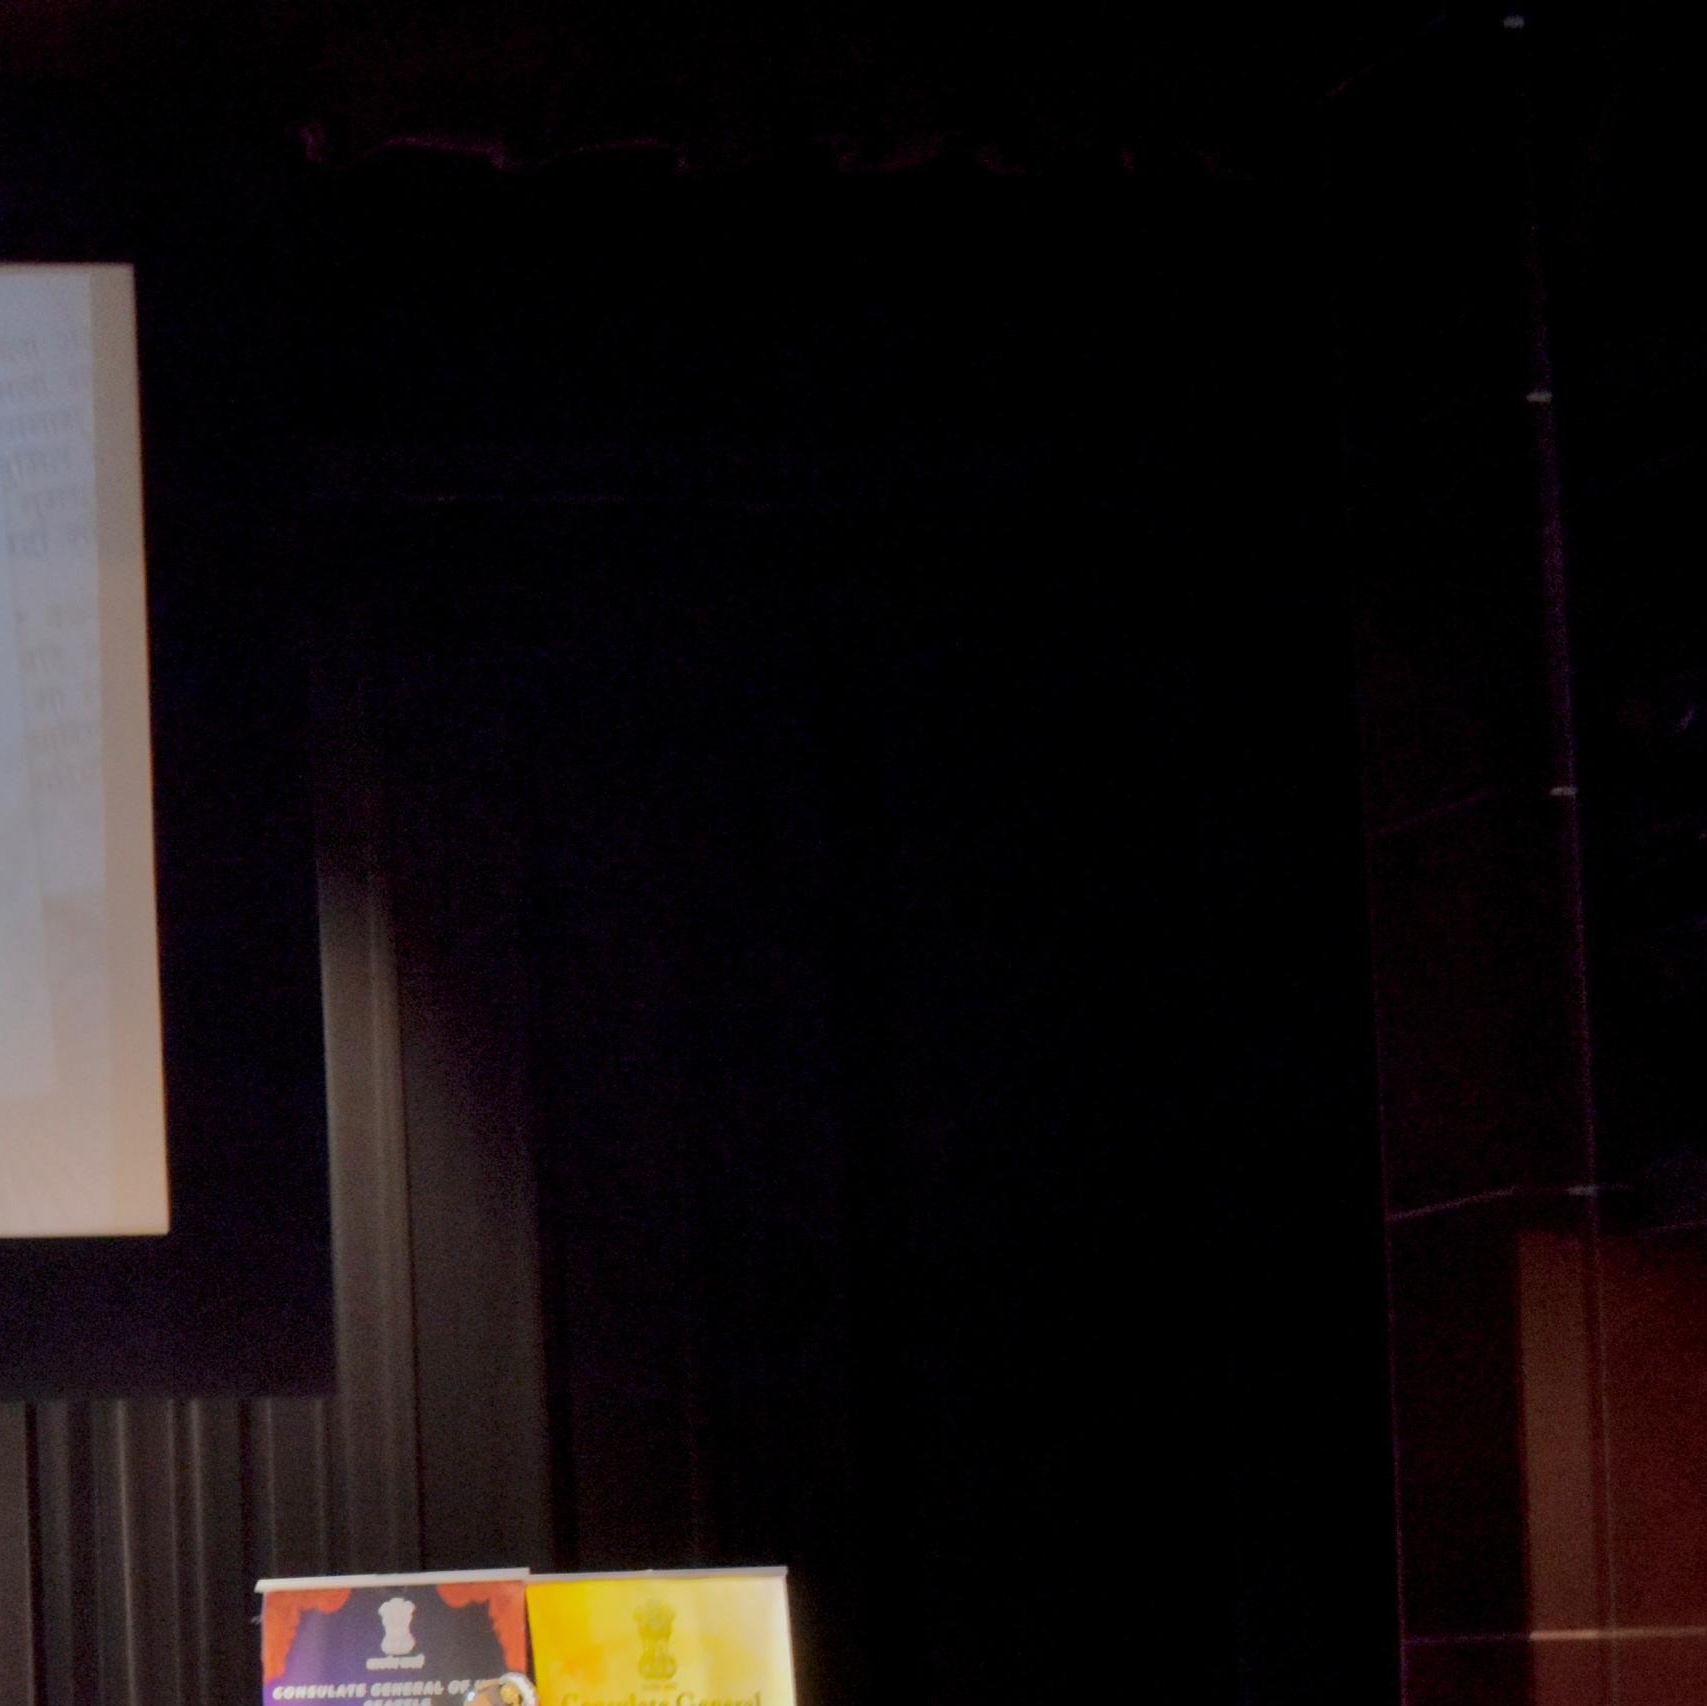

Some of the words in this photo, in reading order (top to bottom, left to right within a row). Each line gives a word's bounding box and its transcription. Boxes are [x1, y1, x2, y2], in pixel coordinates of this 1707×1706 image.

[272, 1683, 367, 1700] CONSULATE
[370, 1680, 444, 1697] GENERAL
[447, 1679, 470, 1695] OF
